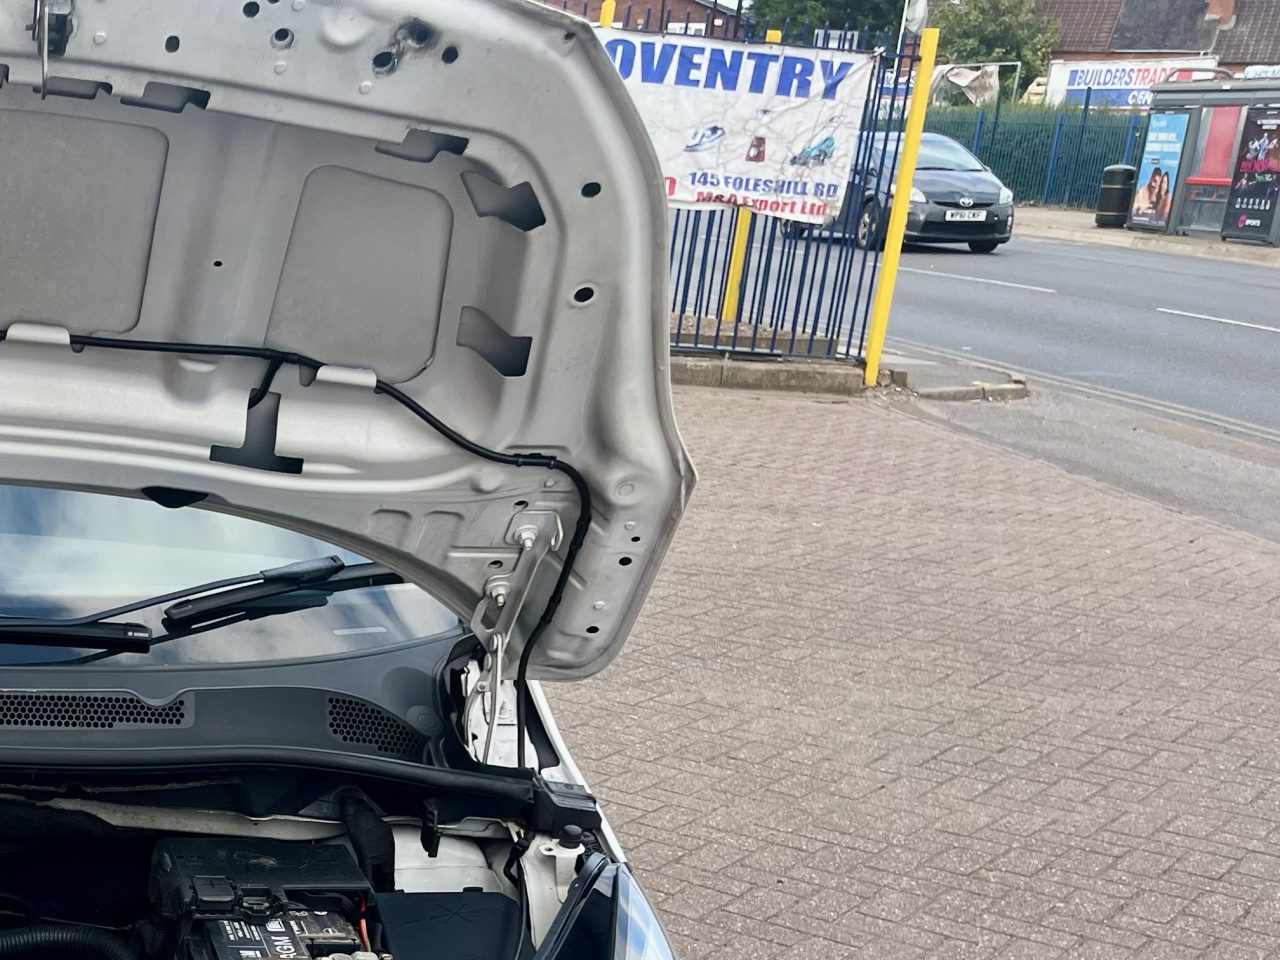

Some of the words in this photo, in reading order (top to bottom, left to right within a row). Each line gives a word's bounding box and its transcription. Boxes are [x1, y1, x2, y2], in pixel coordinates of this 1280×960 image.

[1077, 67, 1175, 86] BUILDERSTRAD
[689, 172, 720, 187] 145
[723, 175, 808, 195] FOLESHILL
[813, 182, 838, 198] RD
[800, 199, 828, 216] Ltd
[271, 936, 297, 959] AGM
